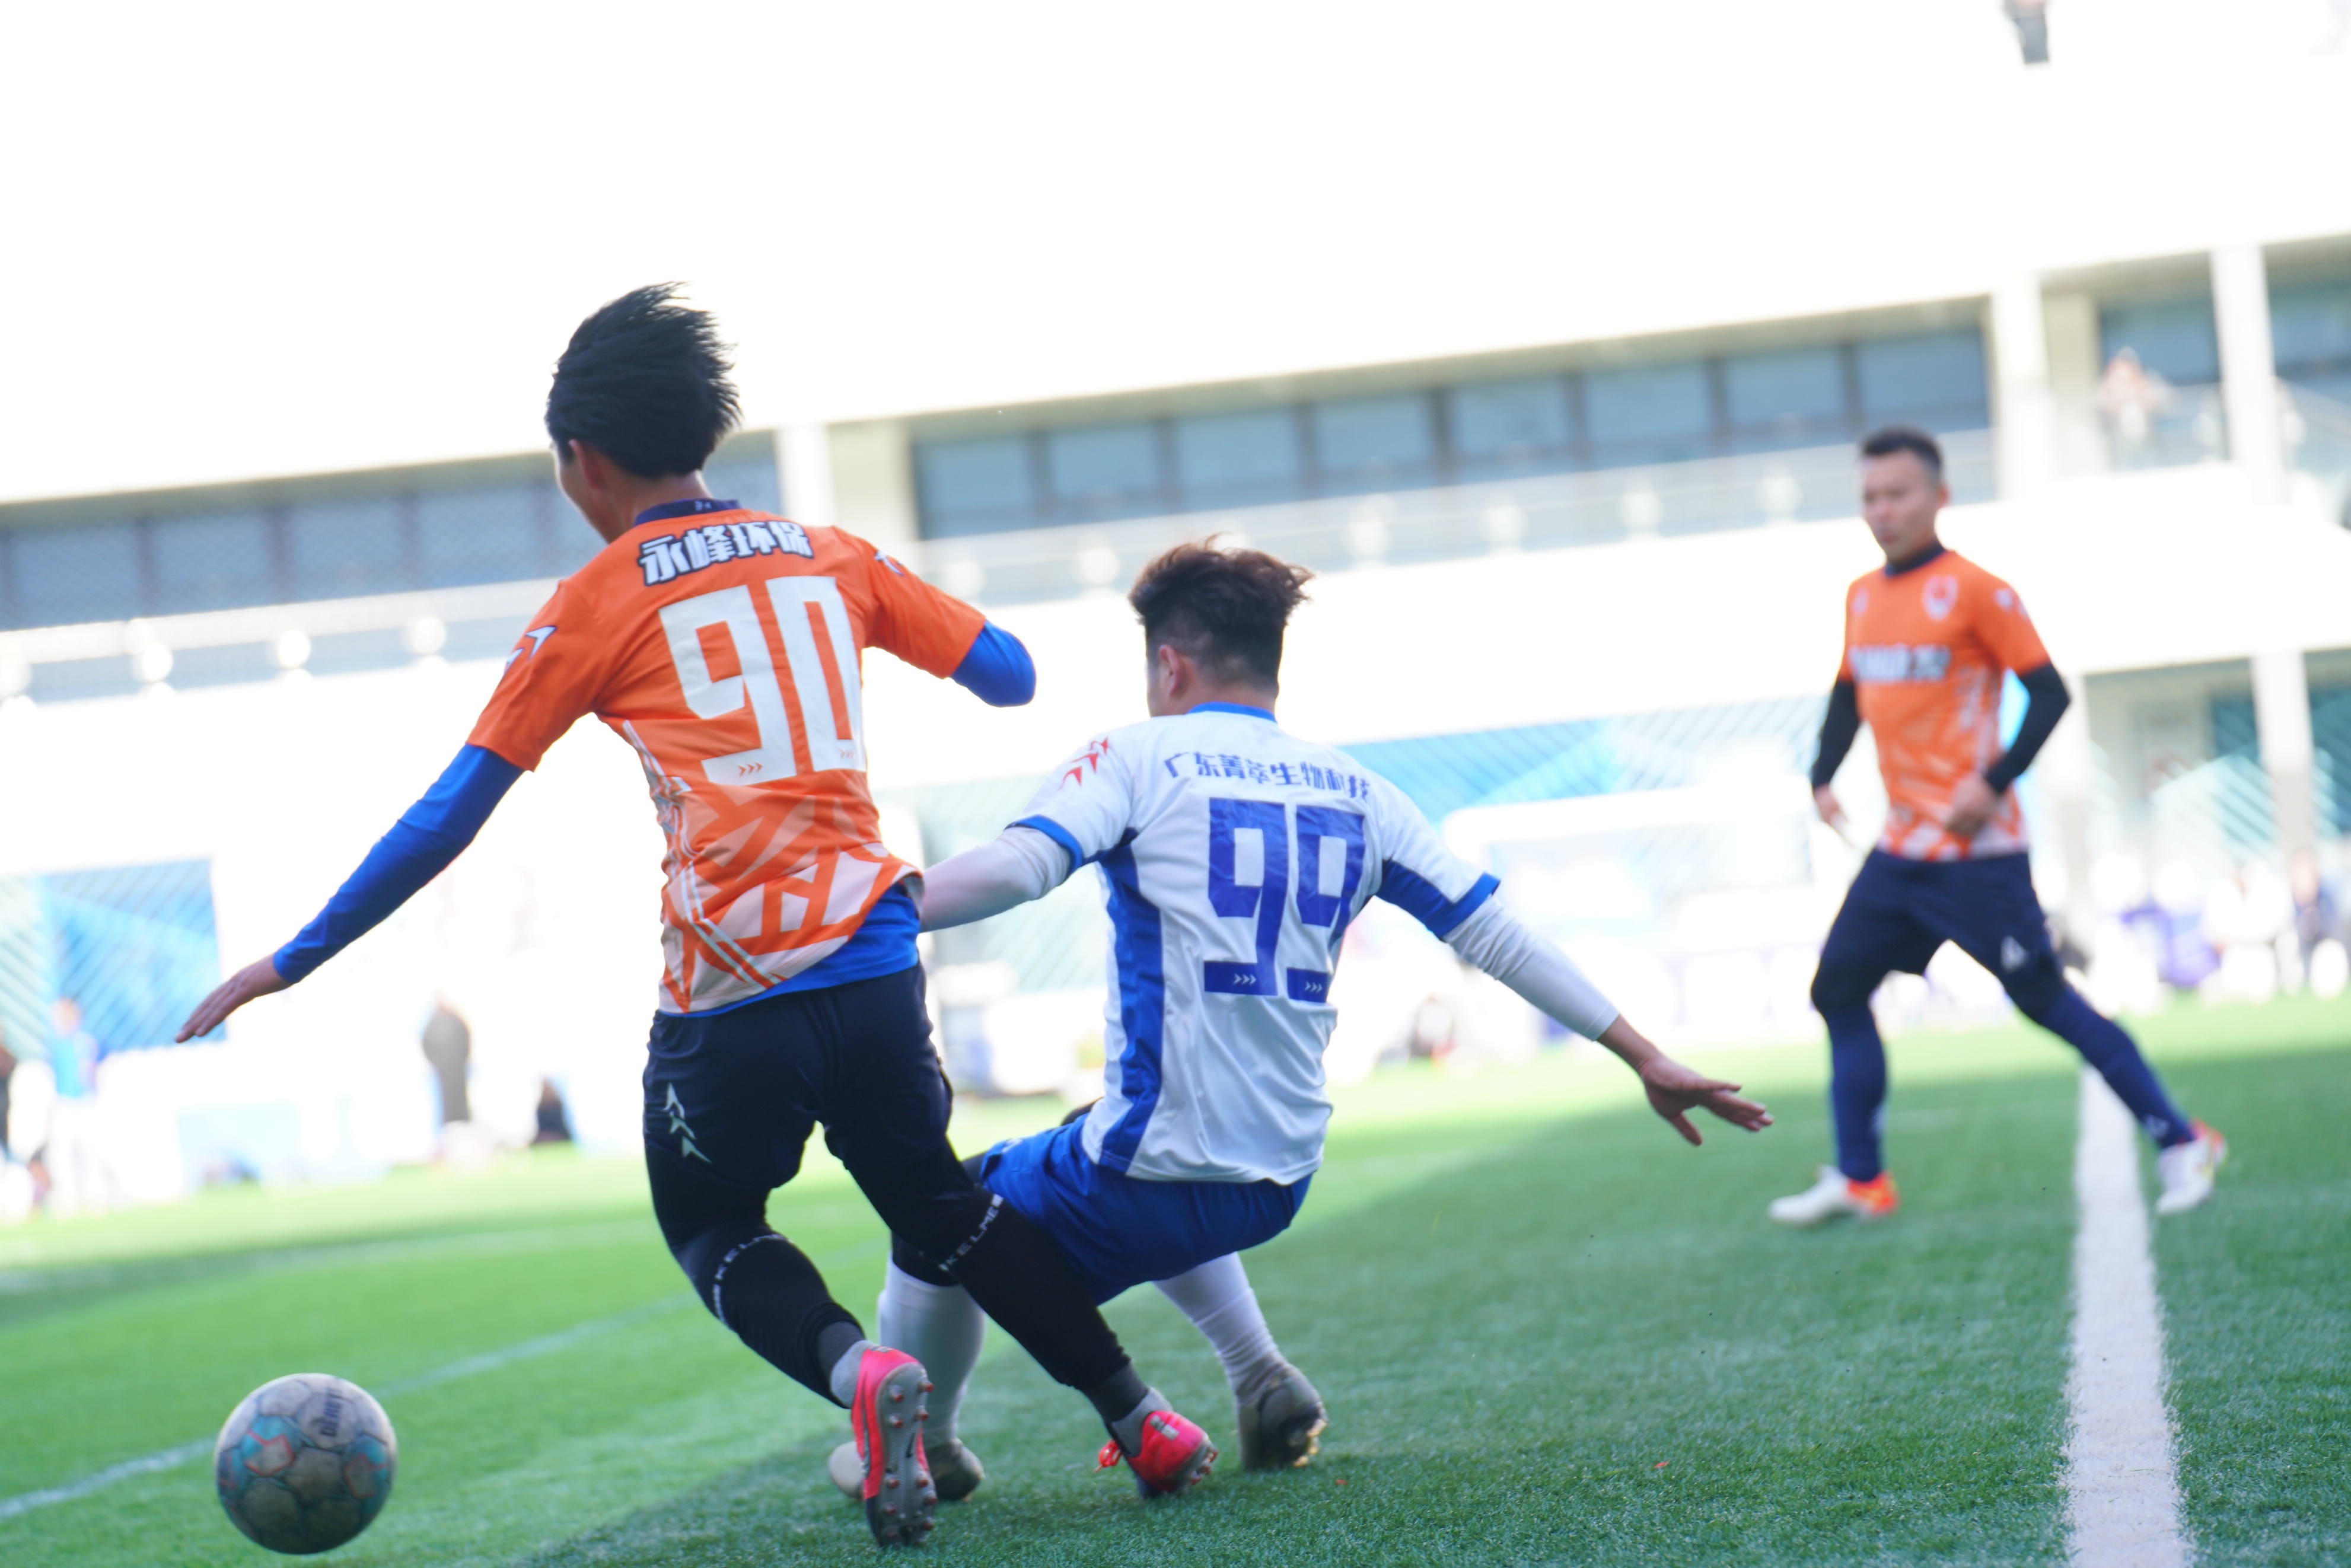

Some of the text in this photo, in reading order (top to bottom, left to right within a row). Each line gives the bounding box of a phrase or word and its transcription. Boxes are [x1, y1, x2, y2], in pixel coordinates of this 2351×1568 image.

[638, 521, 814, 585] 永峰环保
[659, 575, 867, 785] 90
[1204, 798, 1365, 1003] 99
[945, 1206, 999, 1266] KELME
